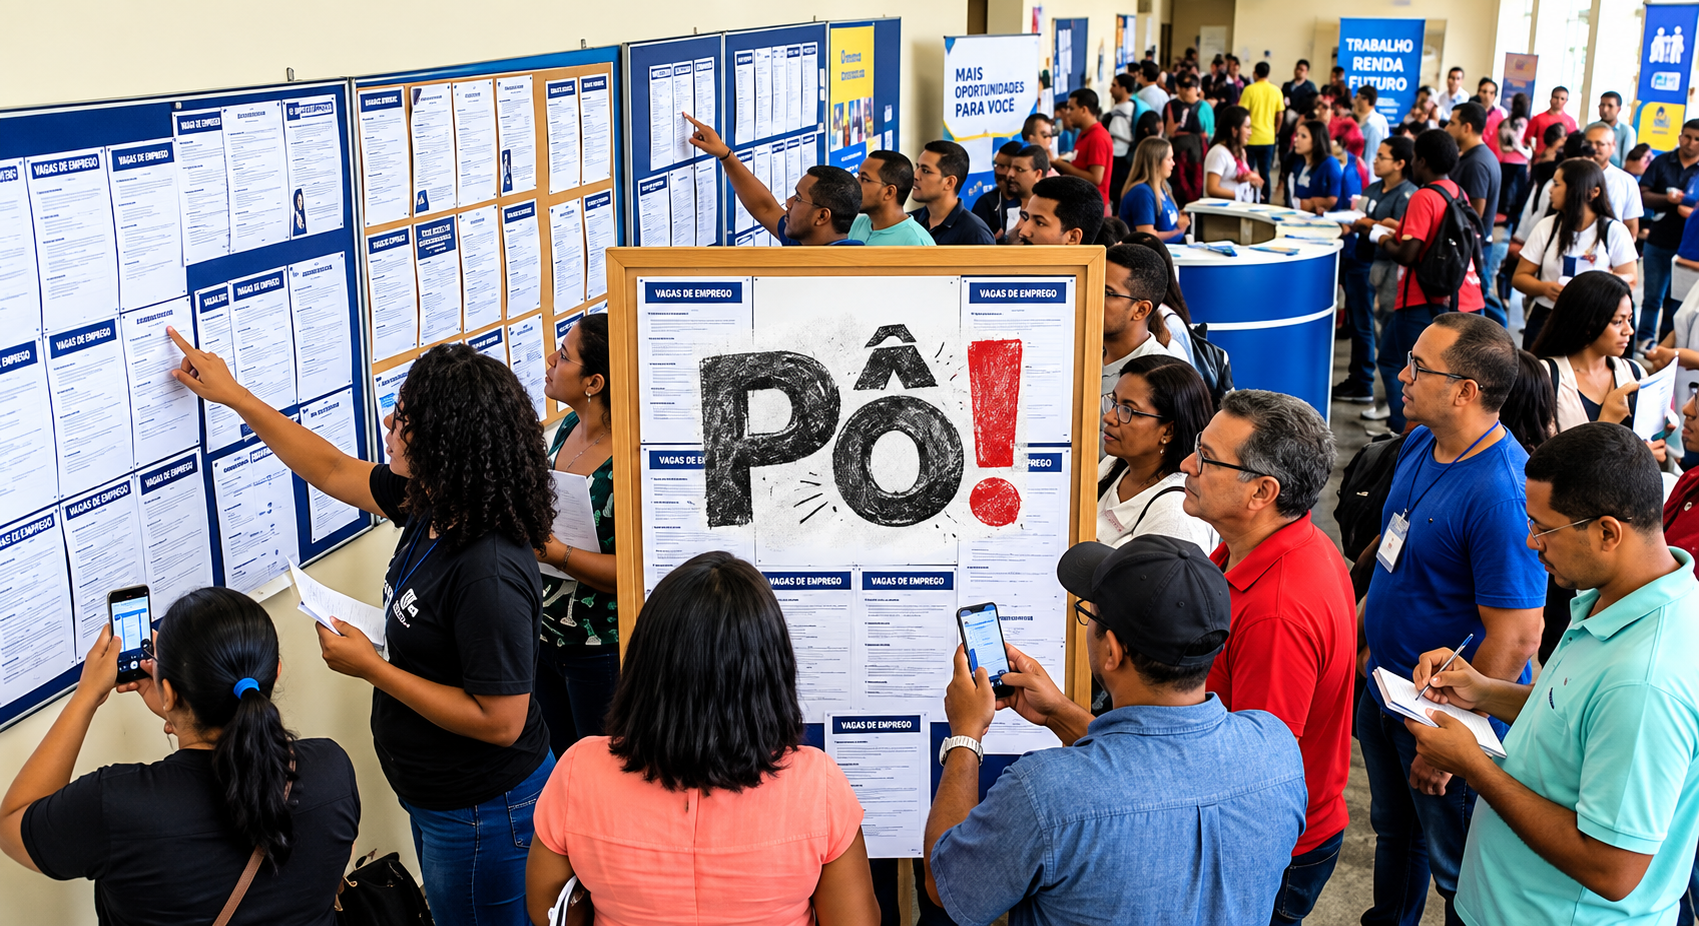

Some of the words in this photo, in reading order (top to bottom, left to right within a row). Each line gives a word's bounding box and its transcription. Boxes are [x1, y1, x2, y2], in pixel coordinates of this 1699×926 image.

[1345, 37, 1414, 53] TRABALHO
[1352, 56, 1404, 72] RENDA
[955, 66, 983, 82] MAIS
[955, 81, 1025, 99] OPORTUNIDADES
[1348, 75, 1408, 92] FUTURO
[955, 101, 985, 118] PARA
[987, 97, 1015, 115] VOCÊ
[655, 289, 682, 298] VAGAS
[682, 289, 693, 298] DE
[694, 289, 732, 298] EMPREGO
[979, 289, 1007, 298] VAGAS
[1007, 289, 1018, 298] DE
[1019, 289, 1057, 298] EMPREGO
[659, 456, 685, 465] VAGAS
[686, 456, 697, 465] DE
[769, 577, 795, 586] VAGAS
[796, 577, 806, 586] DE
[807, 577, 842, 586] EMPREGO
[871, 577, 897, 586] VAGAS
[897, 577, 908, 586] DE
[909, 577, 945, 586] EMPREGO
[841, 721, 866, 730] VAGAS
[866, 721, 877, 730] DE
[877, 720, 912, 729] EMPREGO
